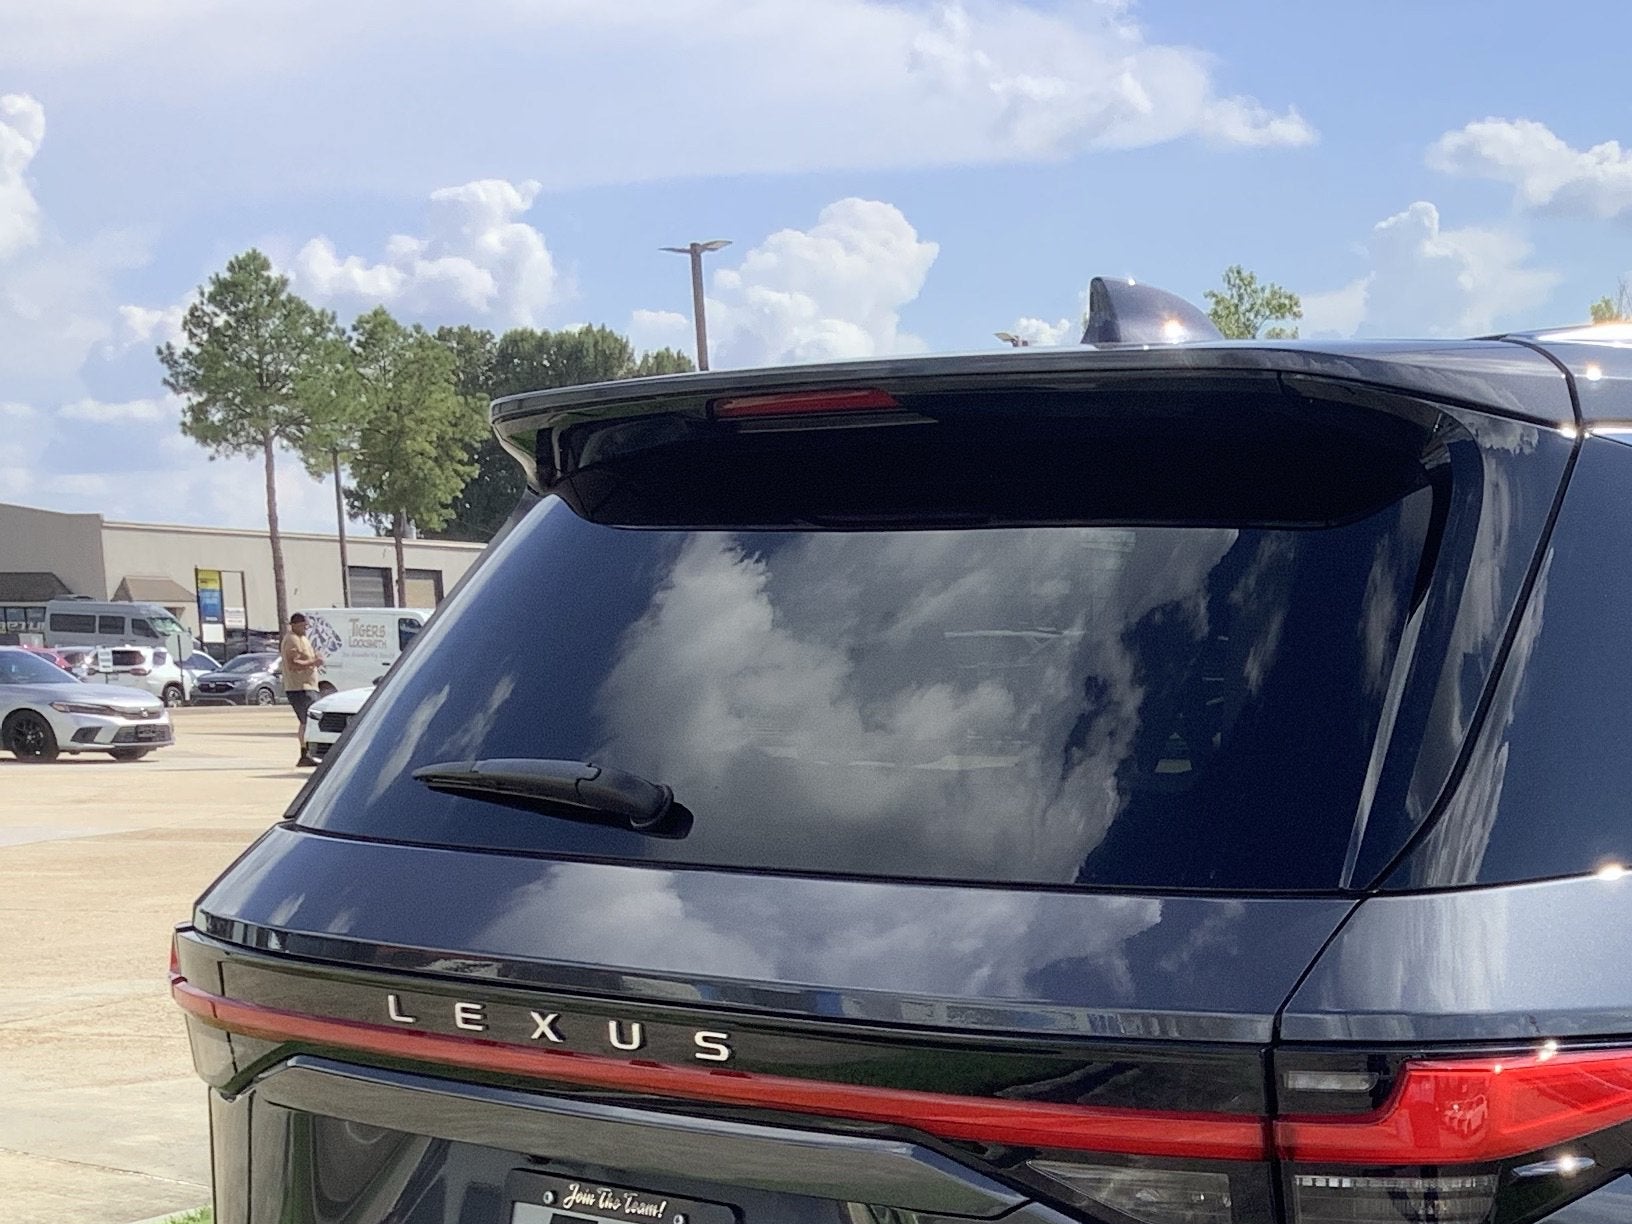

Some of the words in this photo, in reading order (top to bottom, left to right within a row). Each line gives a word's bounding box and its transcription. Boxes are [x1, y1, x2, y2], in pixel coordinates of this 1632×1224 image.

[388, 995, 732, 1062] LEXUS
[563, 1183, 596, 1209] Join
[597, 1188, 621, 1211] The
[623, 1192, 667, 1218] Team!
